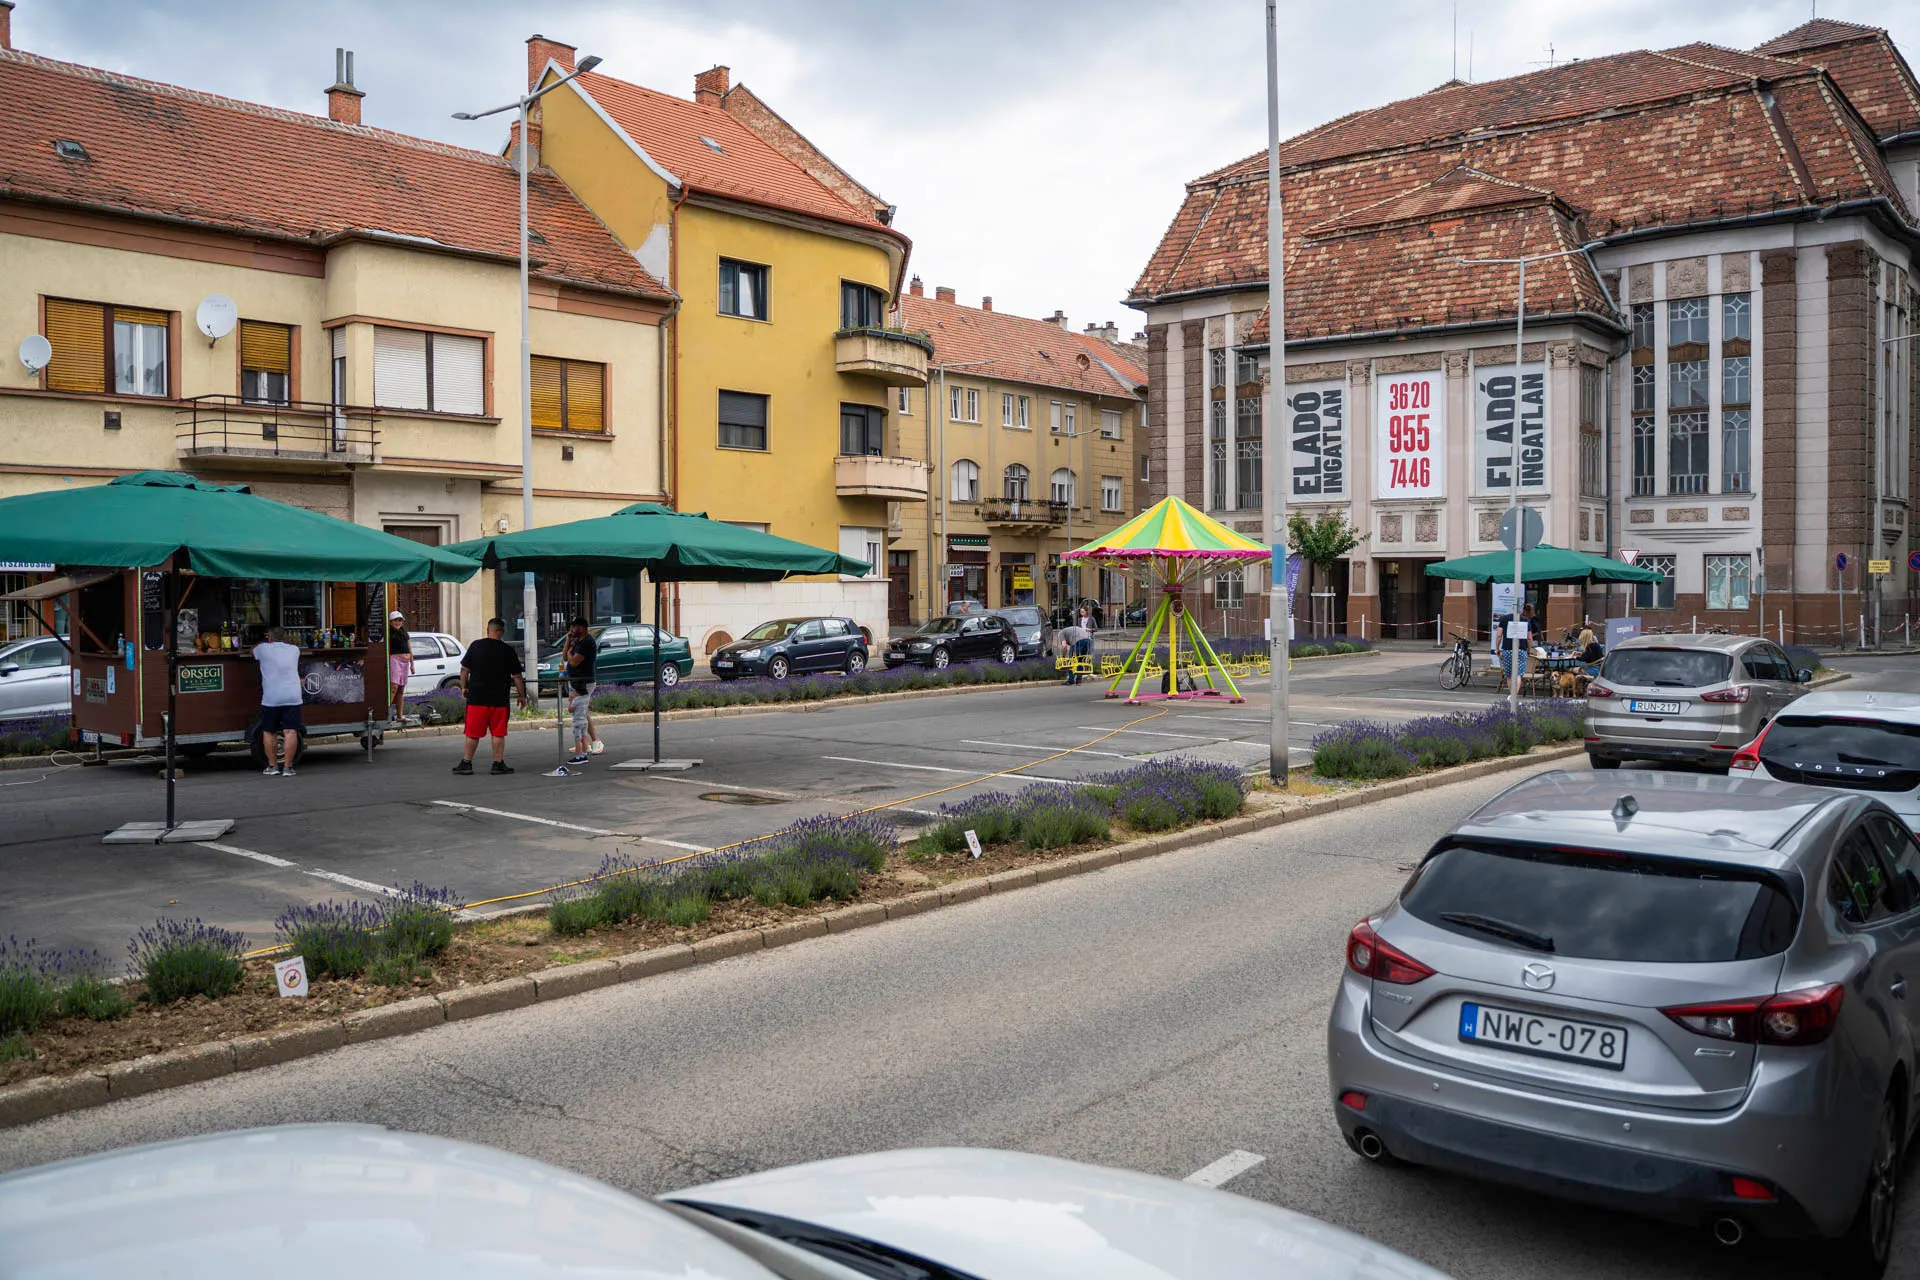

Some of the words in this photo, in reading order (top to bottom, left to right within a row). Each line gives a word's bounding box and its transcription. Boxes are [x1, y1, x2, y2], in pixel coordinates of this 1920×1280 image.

[1287, 391, 1322, 495] ELADÓ
[1323, 389, 1342, 494] INGATLAN
[1389, 414, 1430, 453] 955
[1522, 373, 1544, 486] INGATLAN
[1389, 457, 1430, 488] 7446
[1637, 702, 1677, 712] RUN-217
[1794, 762, 1885, 776] VOLVO
[1482, 1011, 1617, 1059] NWC-078
